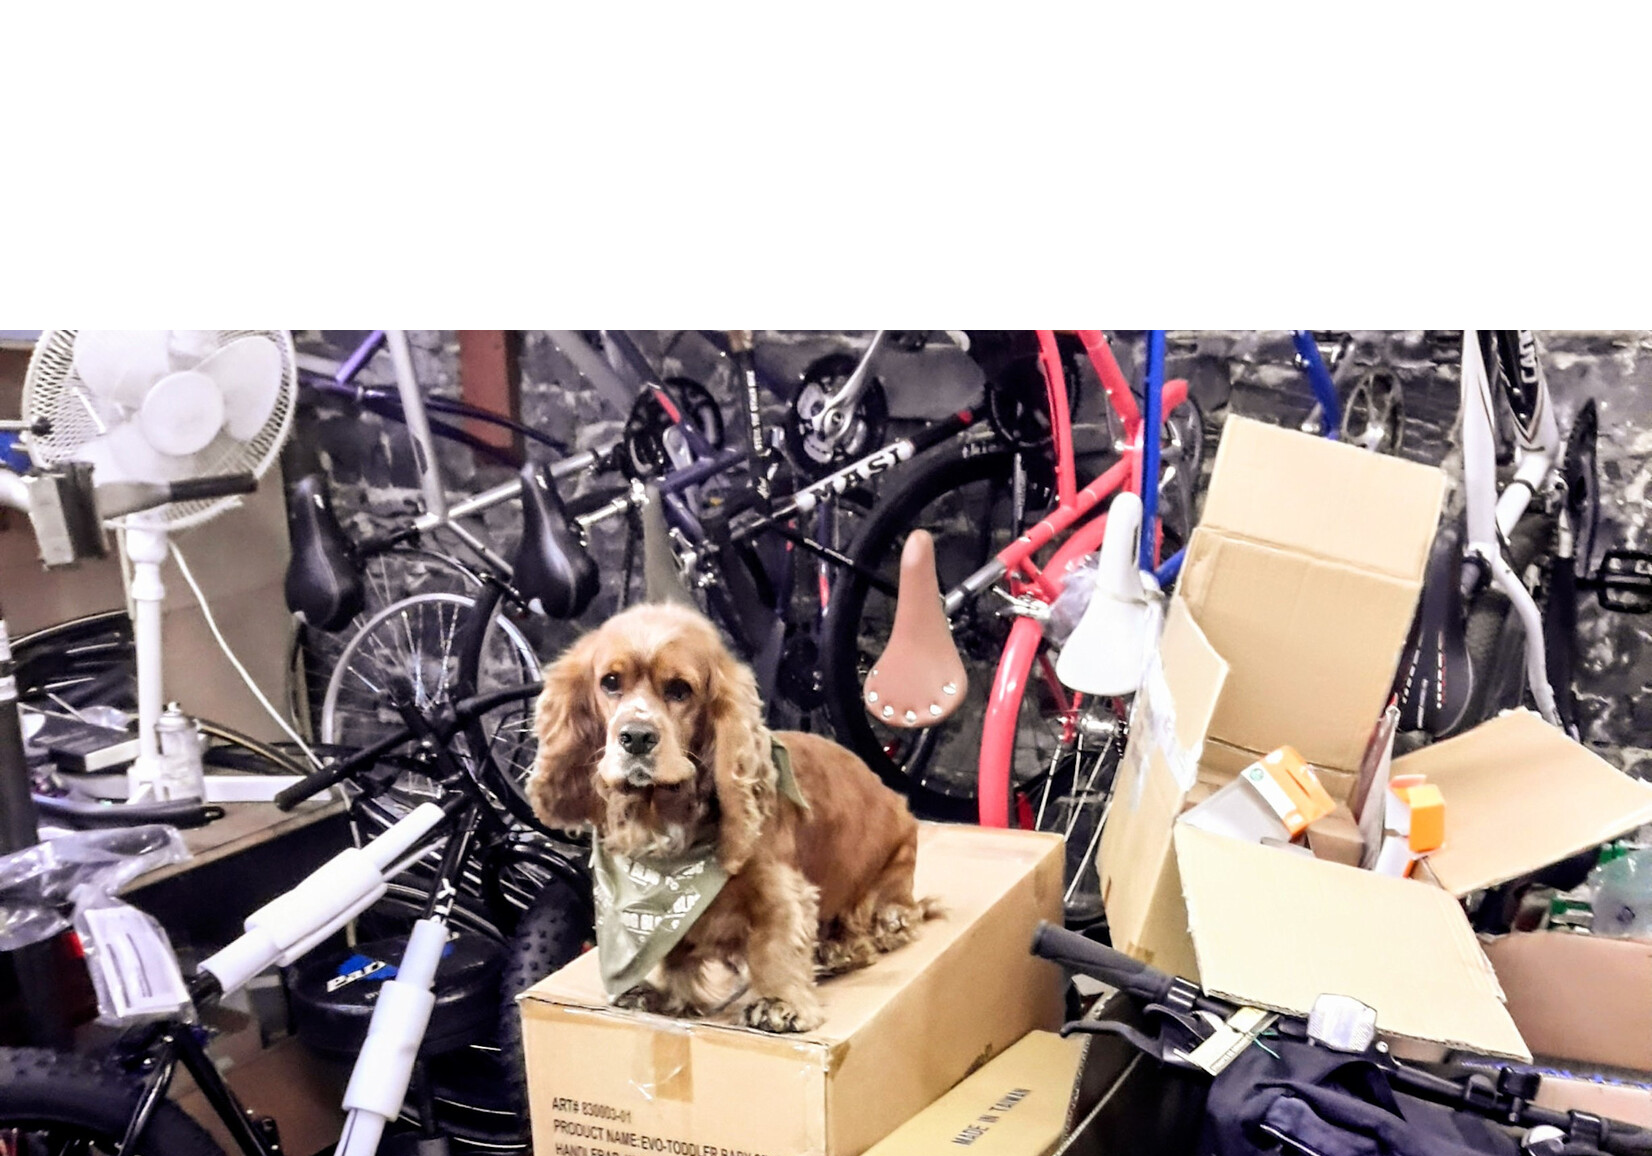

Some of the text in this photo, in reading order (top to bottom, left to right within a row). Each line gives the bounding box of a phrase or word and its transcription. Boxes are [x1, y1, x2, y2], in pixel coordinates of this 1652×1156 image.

[809, 447, 902, 504] MASI
[552, 1096, 579, 1114] ART#
[951, 1087, 1032, 1146] MADE IN TAIWAN
[553, 1118, 605, 1141] PRODUCT
